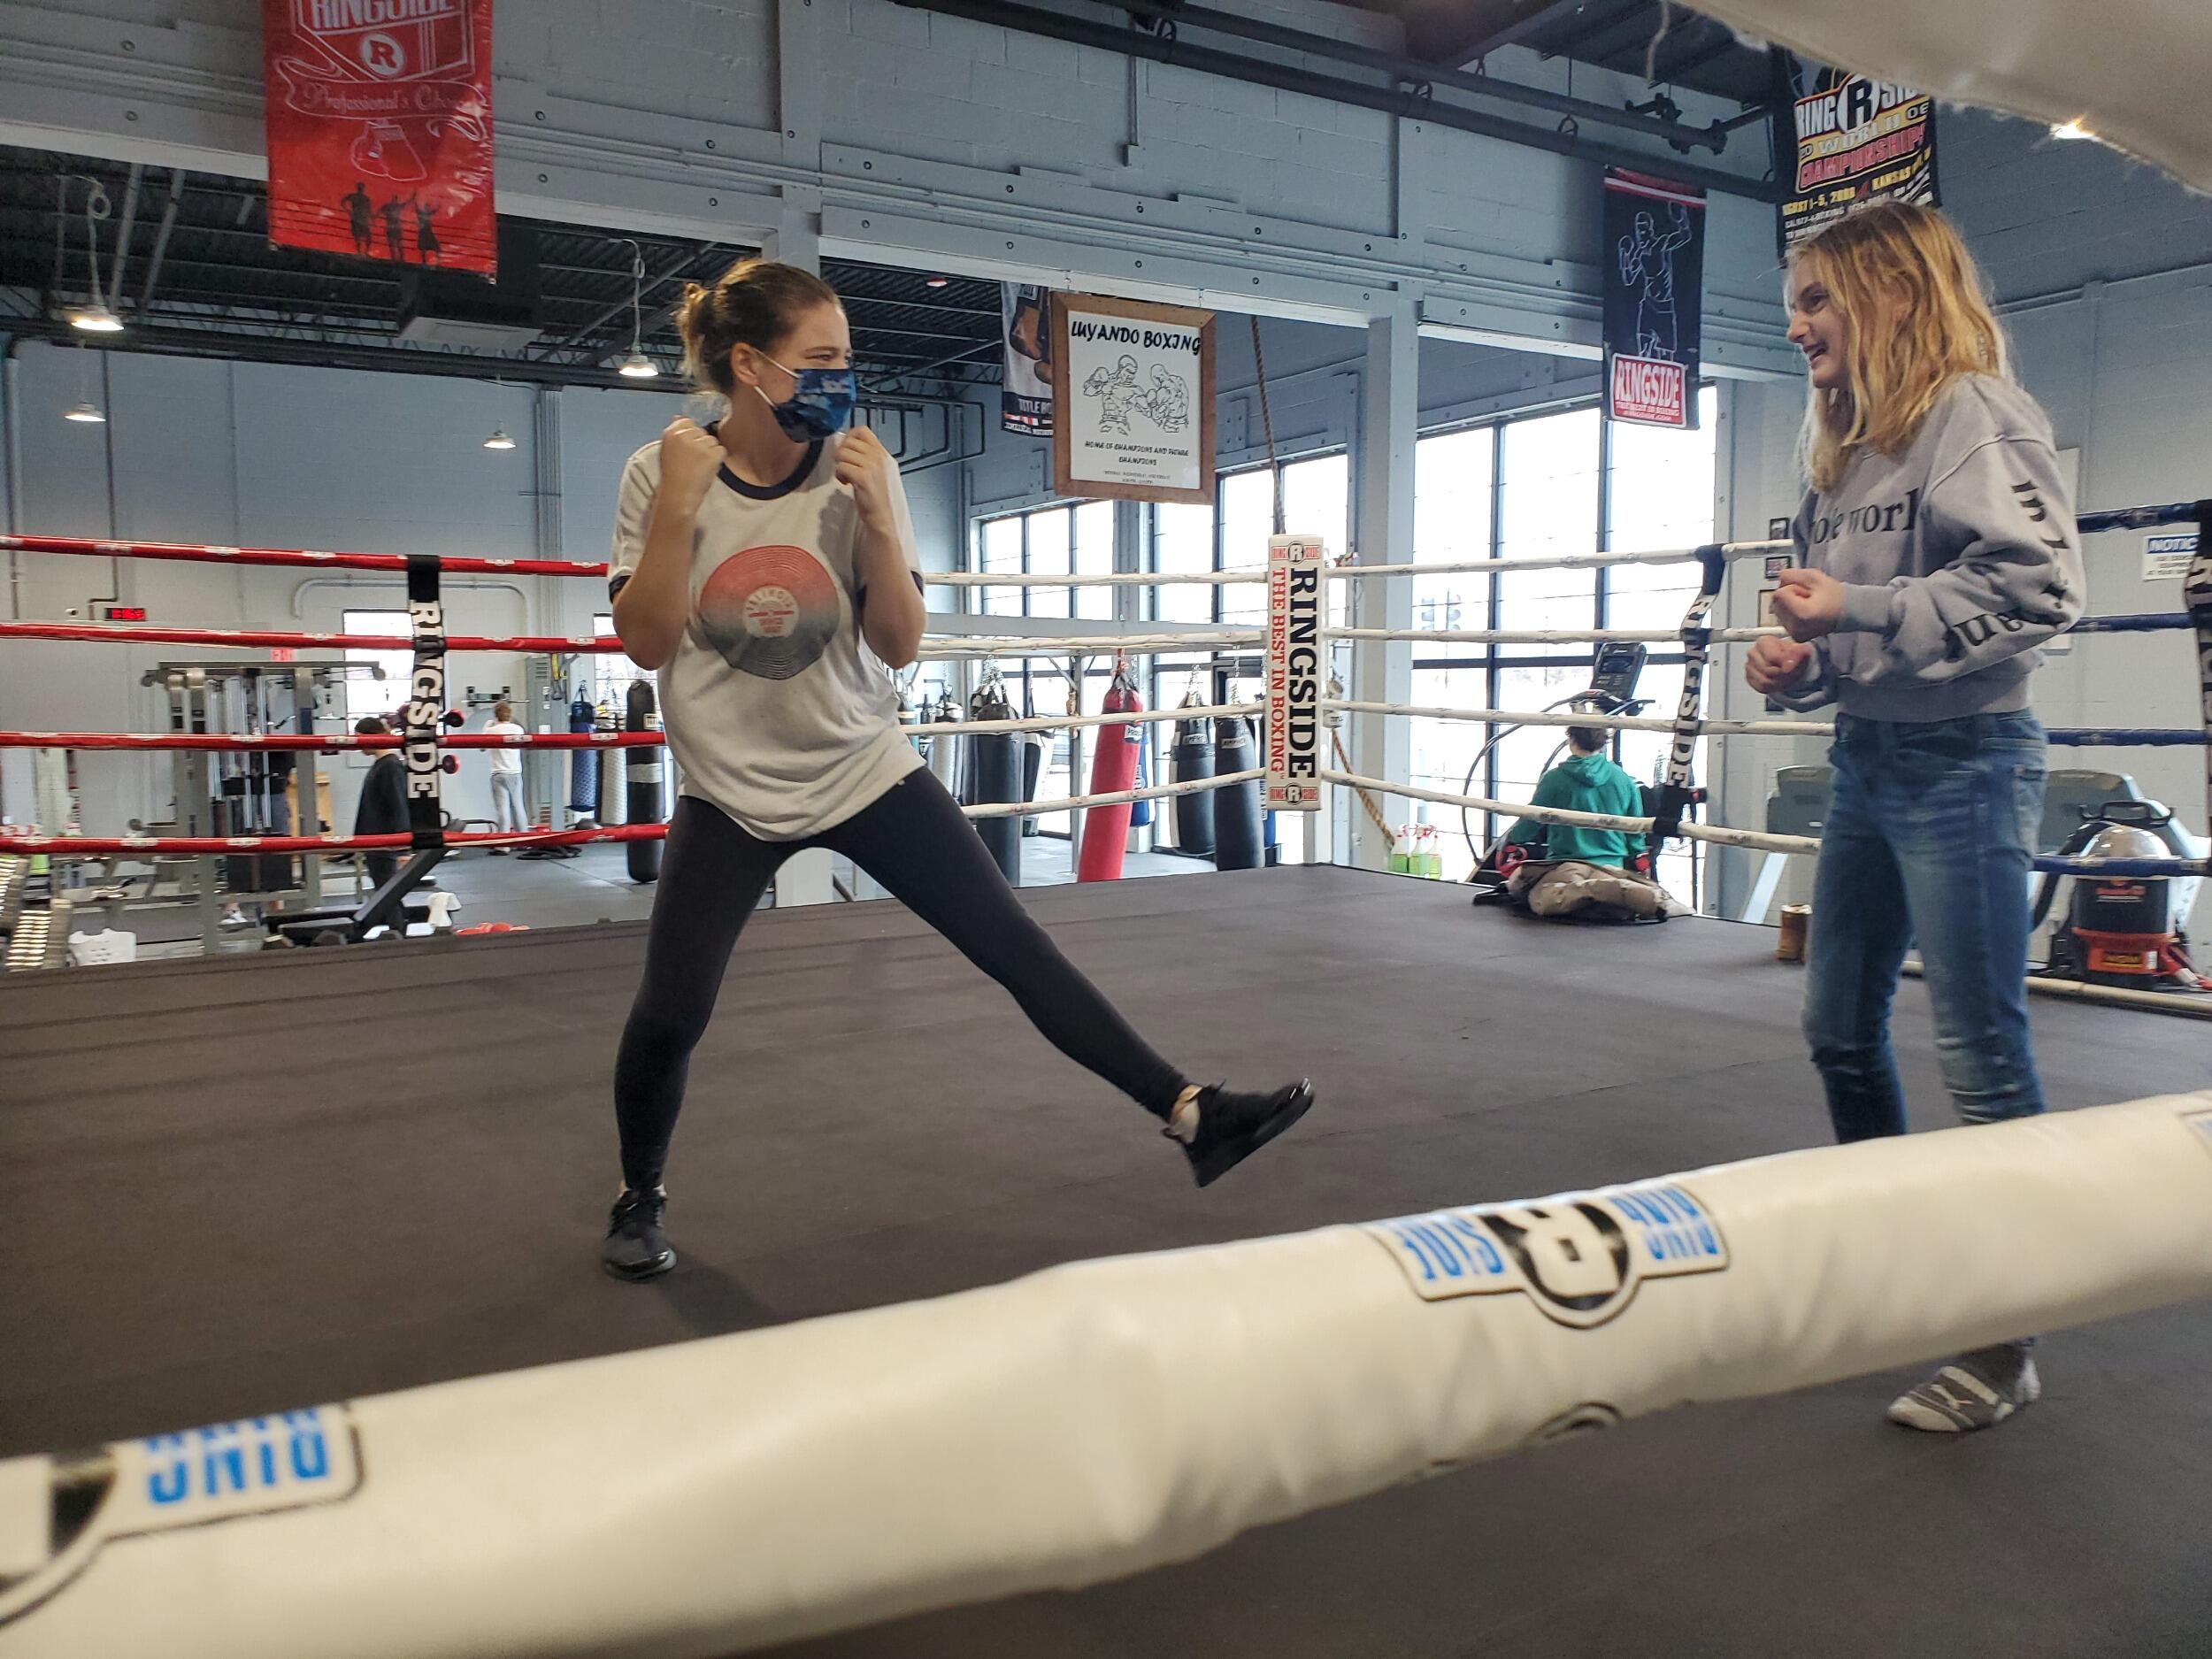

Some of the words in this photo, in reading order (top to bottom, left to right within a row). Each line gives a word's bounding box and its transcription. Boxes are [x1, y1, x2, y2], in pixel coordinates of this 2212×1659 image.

[369, 41, 398, 69] R
[1795, 95, 1837, 142] RING
[1071, 320, 1141, 345] LUYANDO
[1143, 330, 1202, 356] BOXING
[1615, 360, 1680, 409] RINGSIDE
[2148, 537, 2199, 552] NOTIC
[1271, 567, 1286, 611] THE
[1271, 614, 1286, 664] BEST
[1271, 670, 1286, 691] IN
[1288, 567, 1317, 779] RINGSIDE
[1667, 593, 1715, 789] RINGSIDE
[409, 599, 443, 799] RINGSIDE
[1270, 695, 1286, 773] BOXING
